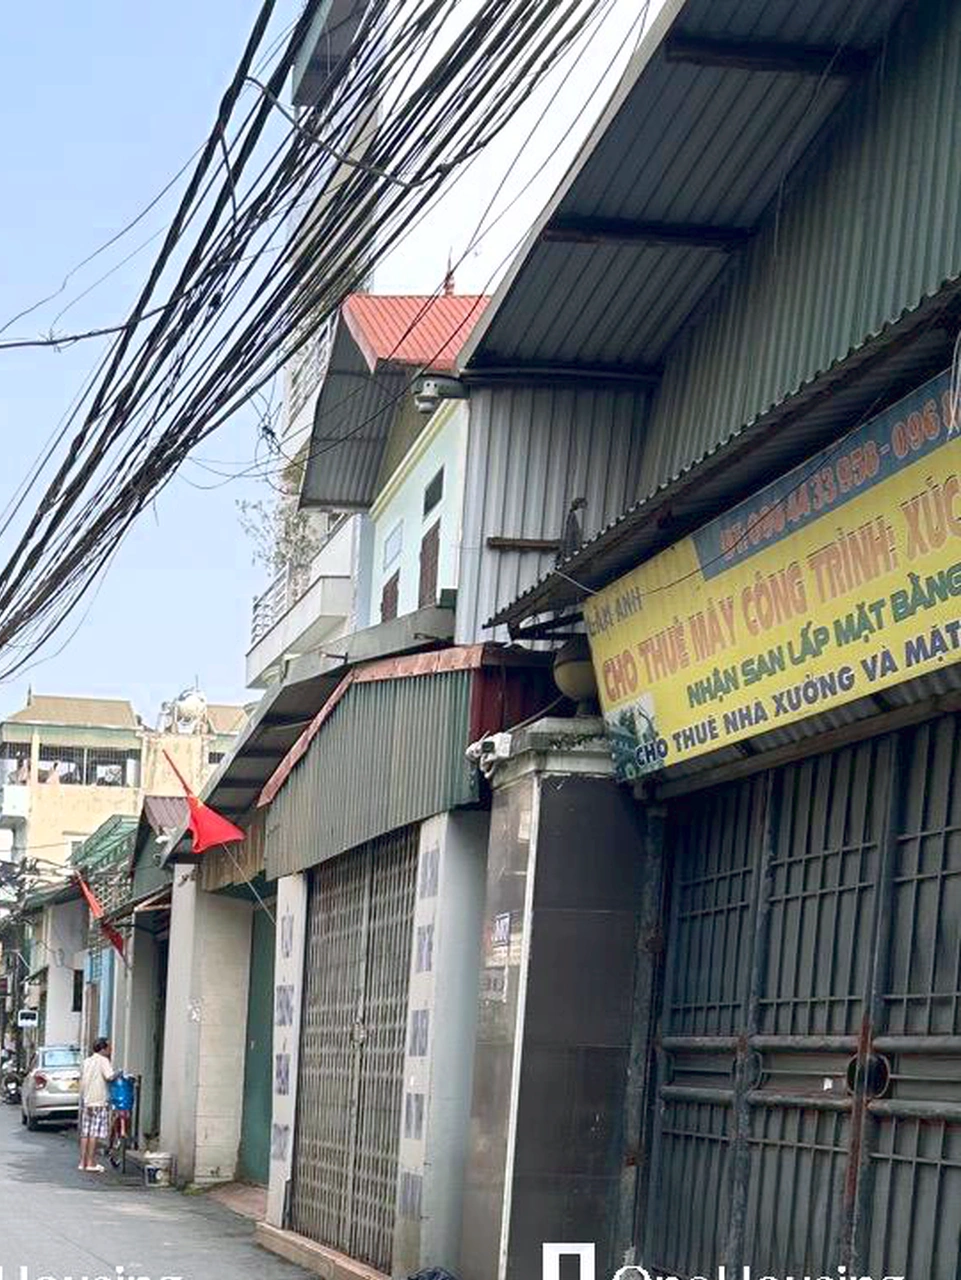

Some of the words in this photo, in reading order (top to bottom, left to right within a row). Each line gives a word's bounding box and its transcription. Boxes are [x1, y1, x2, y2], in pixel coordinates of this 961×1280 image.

[604, 650, 638, 702] CHO
[689, 595, 737, 664] MÁY
[742, 561, 808, 636] CÔNG
[687, 666, 740, 708] NHẬN
[742, 645, 785, 686] SAN
[787, 621, 830, 665] LẤP
[833, 599, 886, 647] MẶT
[635, 737, 669, 767] CHO
[672, 714, 719, 752] THUÊ
[722, 698, 769, 735] NHÀ
[861, 646, 899, 682] VÀ
